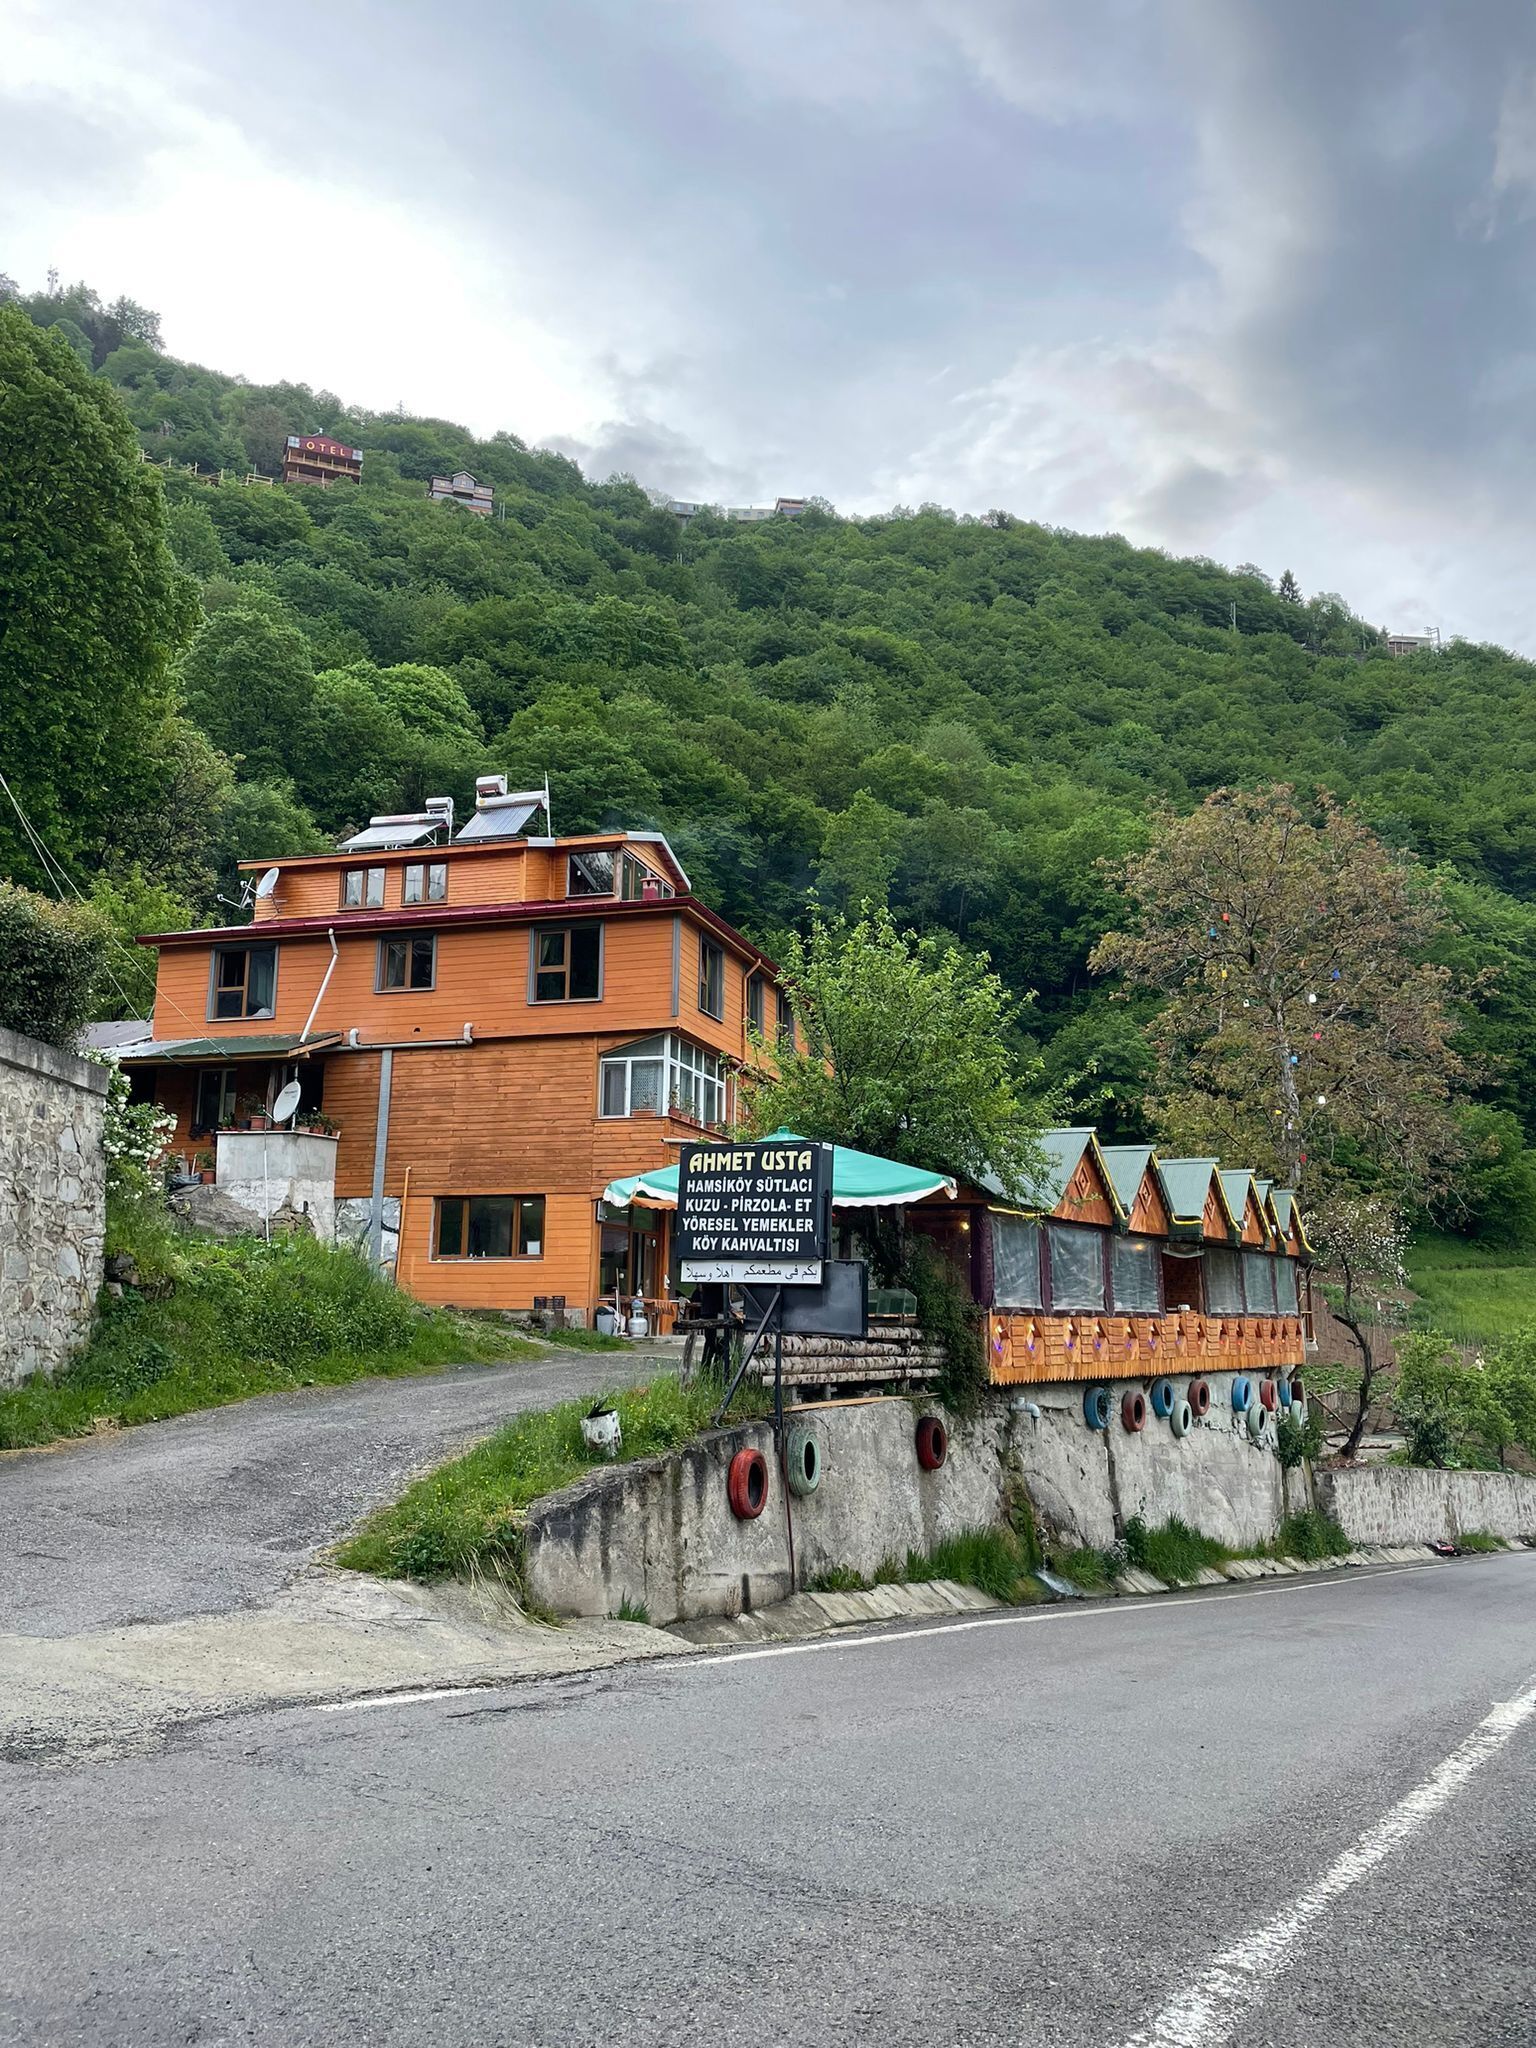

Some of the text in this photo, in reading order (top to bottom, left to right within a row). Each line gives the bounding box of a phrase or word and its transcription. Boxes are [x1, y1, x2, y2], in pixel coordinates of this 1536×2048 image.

[306, 441, 345, 456] OTEL
[689, 1151, 812, 1173] AHMET USTA
[686, 1177, 812, 1193] HAMSİKÖY SÜTLACI
[686, 1199, 720, 1212] KUZU
[795, 1199, 812, 1212] ET
[683, 1216, 813, 1232] YÖRESEL YEMEKLER
[693, 1235, 800, 1252] KÖY KAHVALTISI
